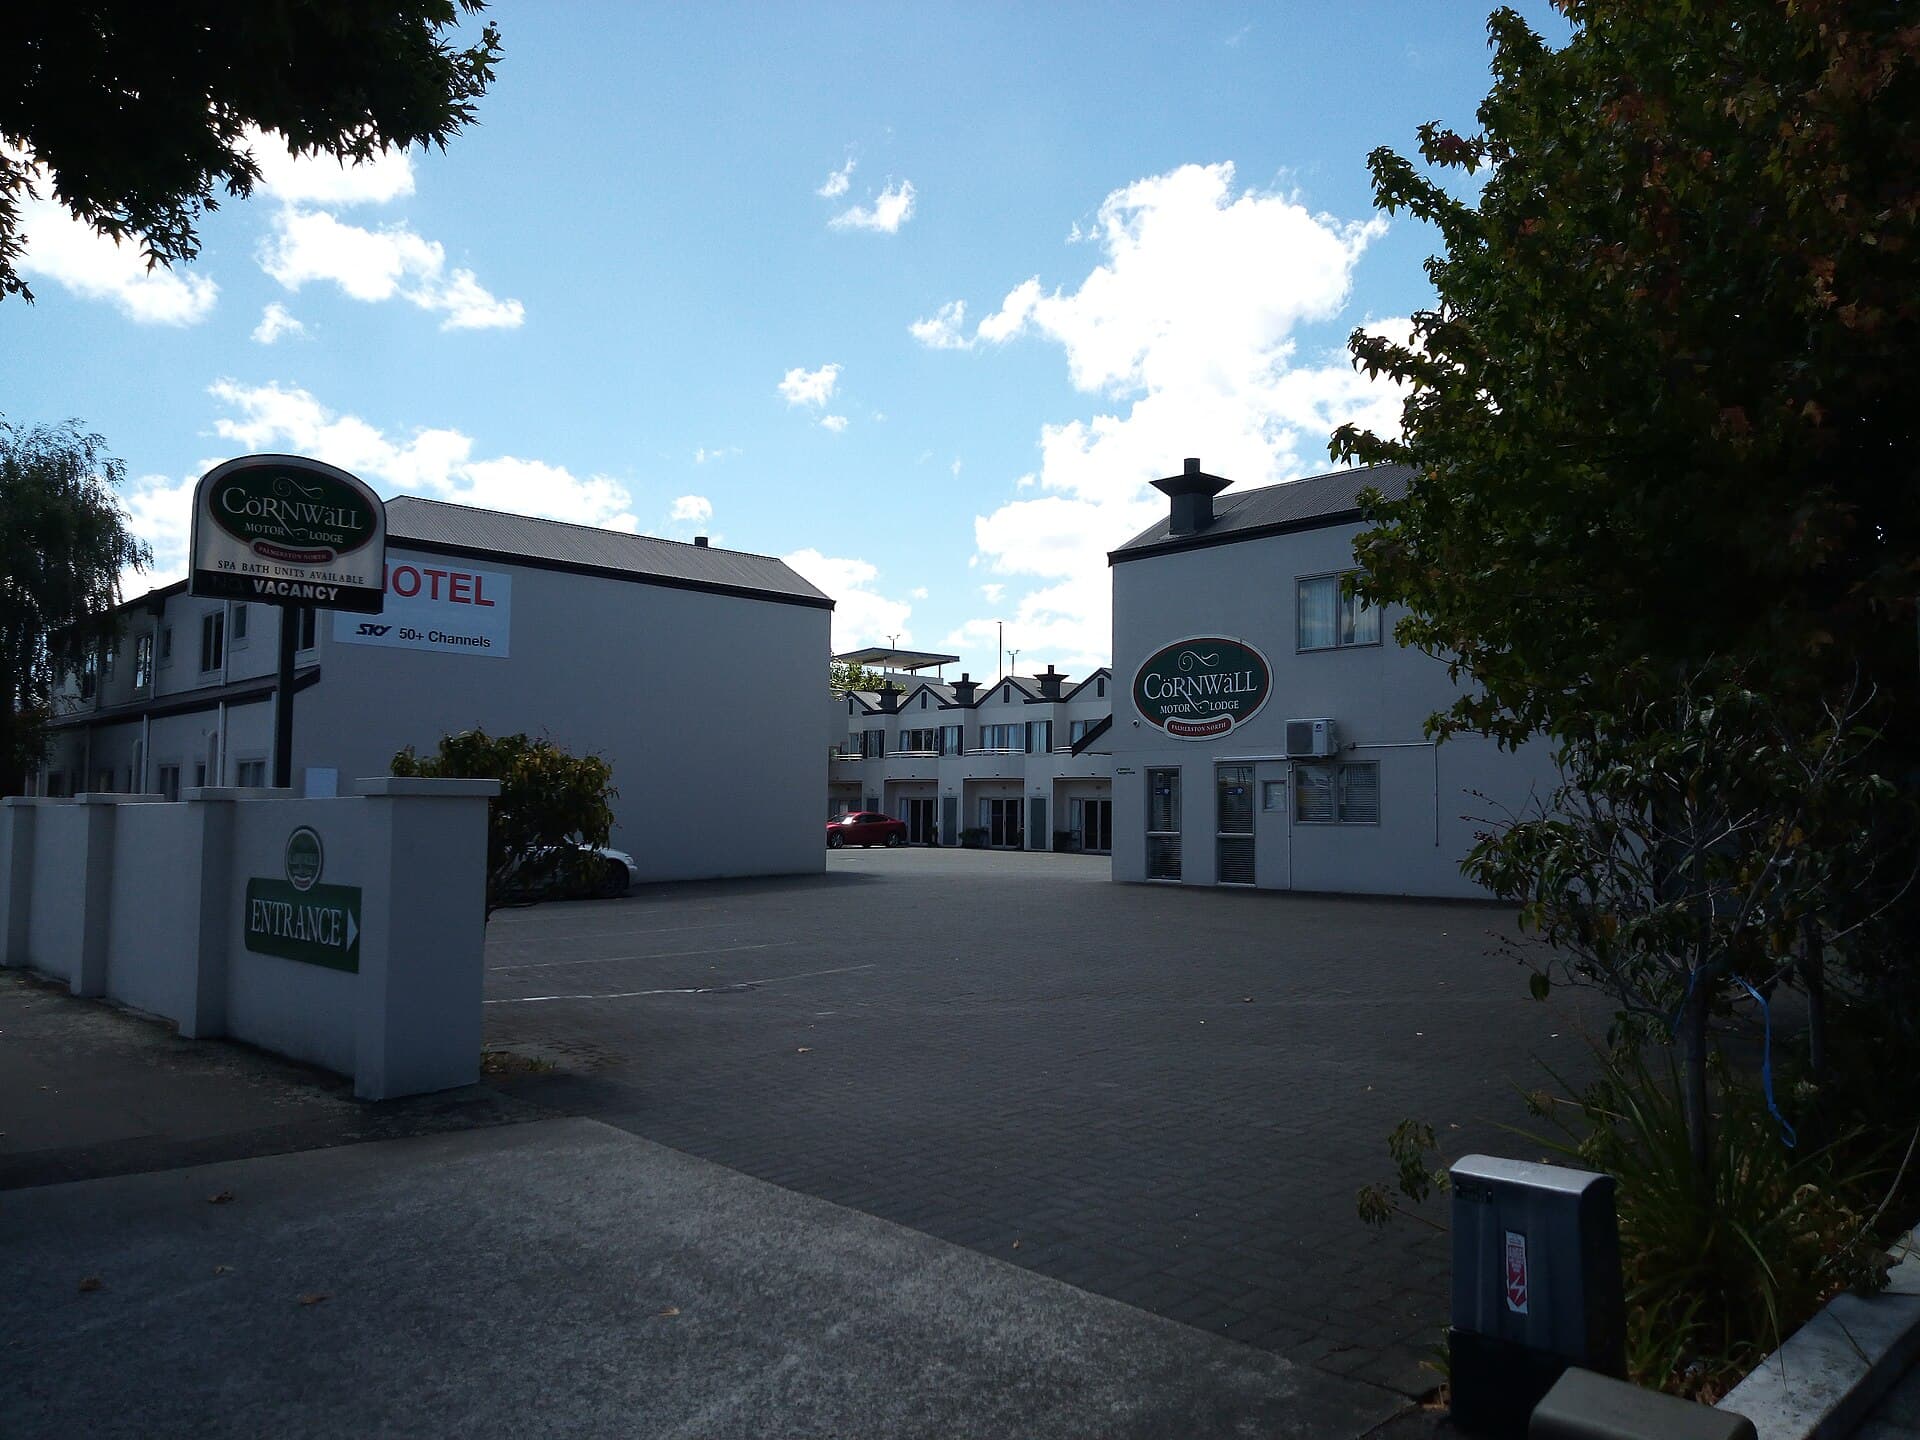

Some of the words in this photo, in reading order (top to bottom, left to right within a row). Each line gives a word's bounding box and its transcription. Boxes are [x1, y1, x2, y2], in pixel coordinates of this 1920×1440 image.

[245, 522, 285, 537] MOTOR
[309, 530, 344, 544] LODGE
[217, 560, 237, 571] SPA
[241, 561, 270, 574] BATH
[274, 566, 305, 578] UNITS
[309, 570, 365, 585] AVAILABLE
[383, 563, 495, 607] OTEL
[253, 579, 339, 601] VACANCY
[356, 623, 392, 637] SKY
[399, 628, 425, 641] 50+
[428, 630, 491, 648] Channels
[1160, 703, 1191, 714] MOTOR
[1209, 700, 1240, 711] LODGE
[251, 898, 343, 947] ENTRANCE
